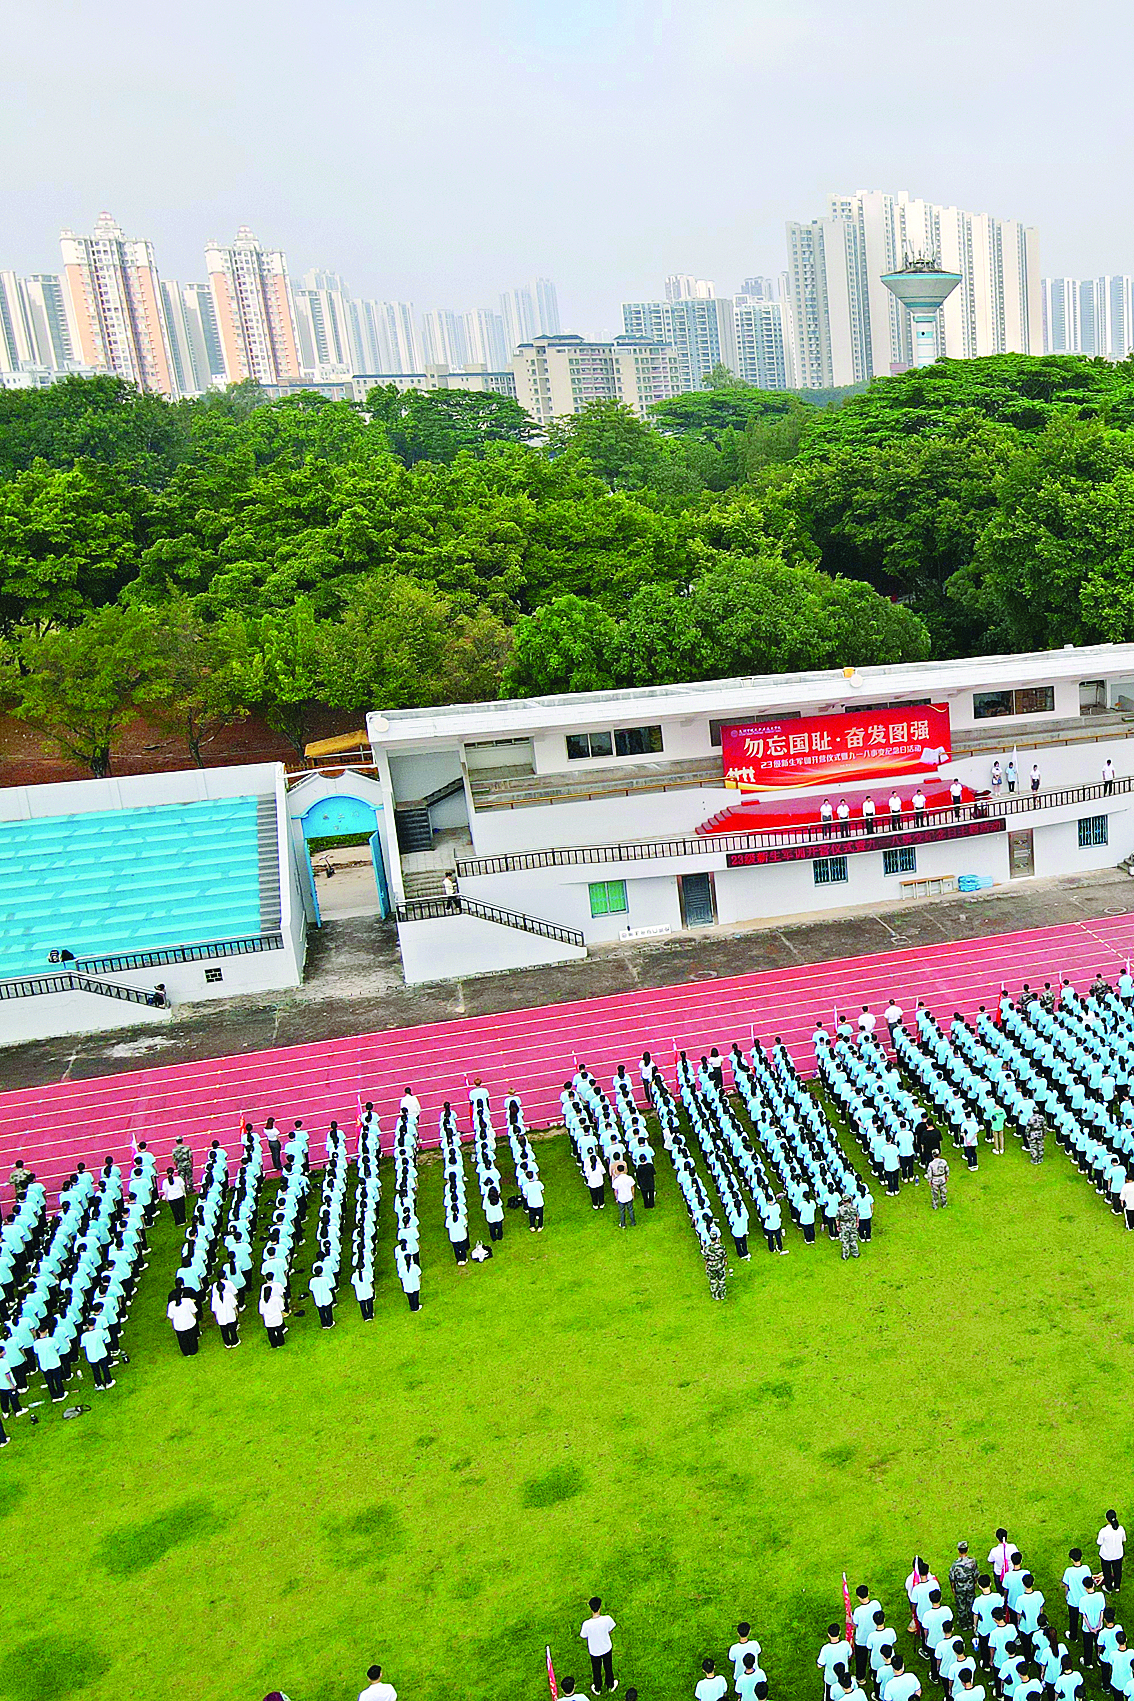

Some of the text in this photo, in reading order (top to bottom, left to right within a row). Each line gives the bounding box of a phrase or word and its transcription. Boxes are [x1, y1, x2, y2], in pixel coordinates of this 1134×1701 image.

[744, 720, 930, 758] 勿忘国耻·奋发图强
